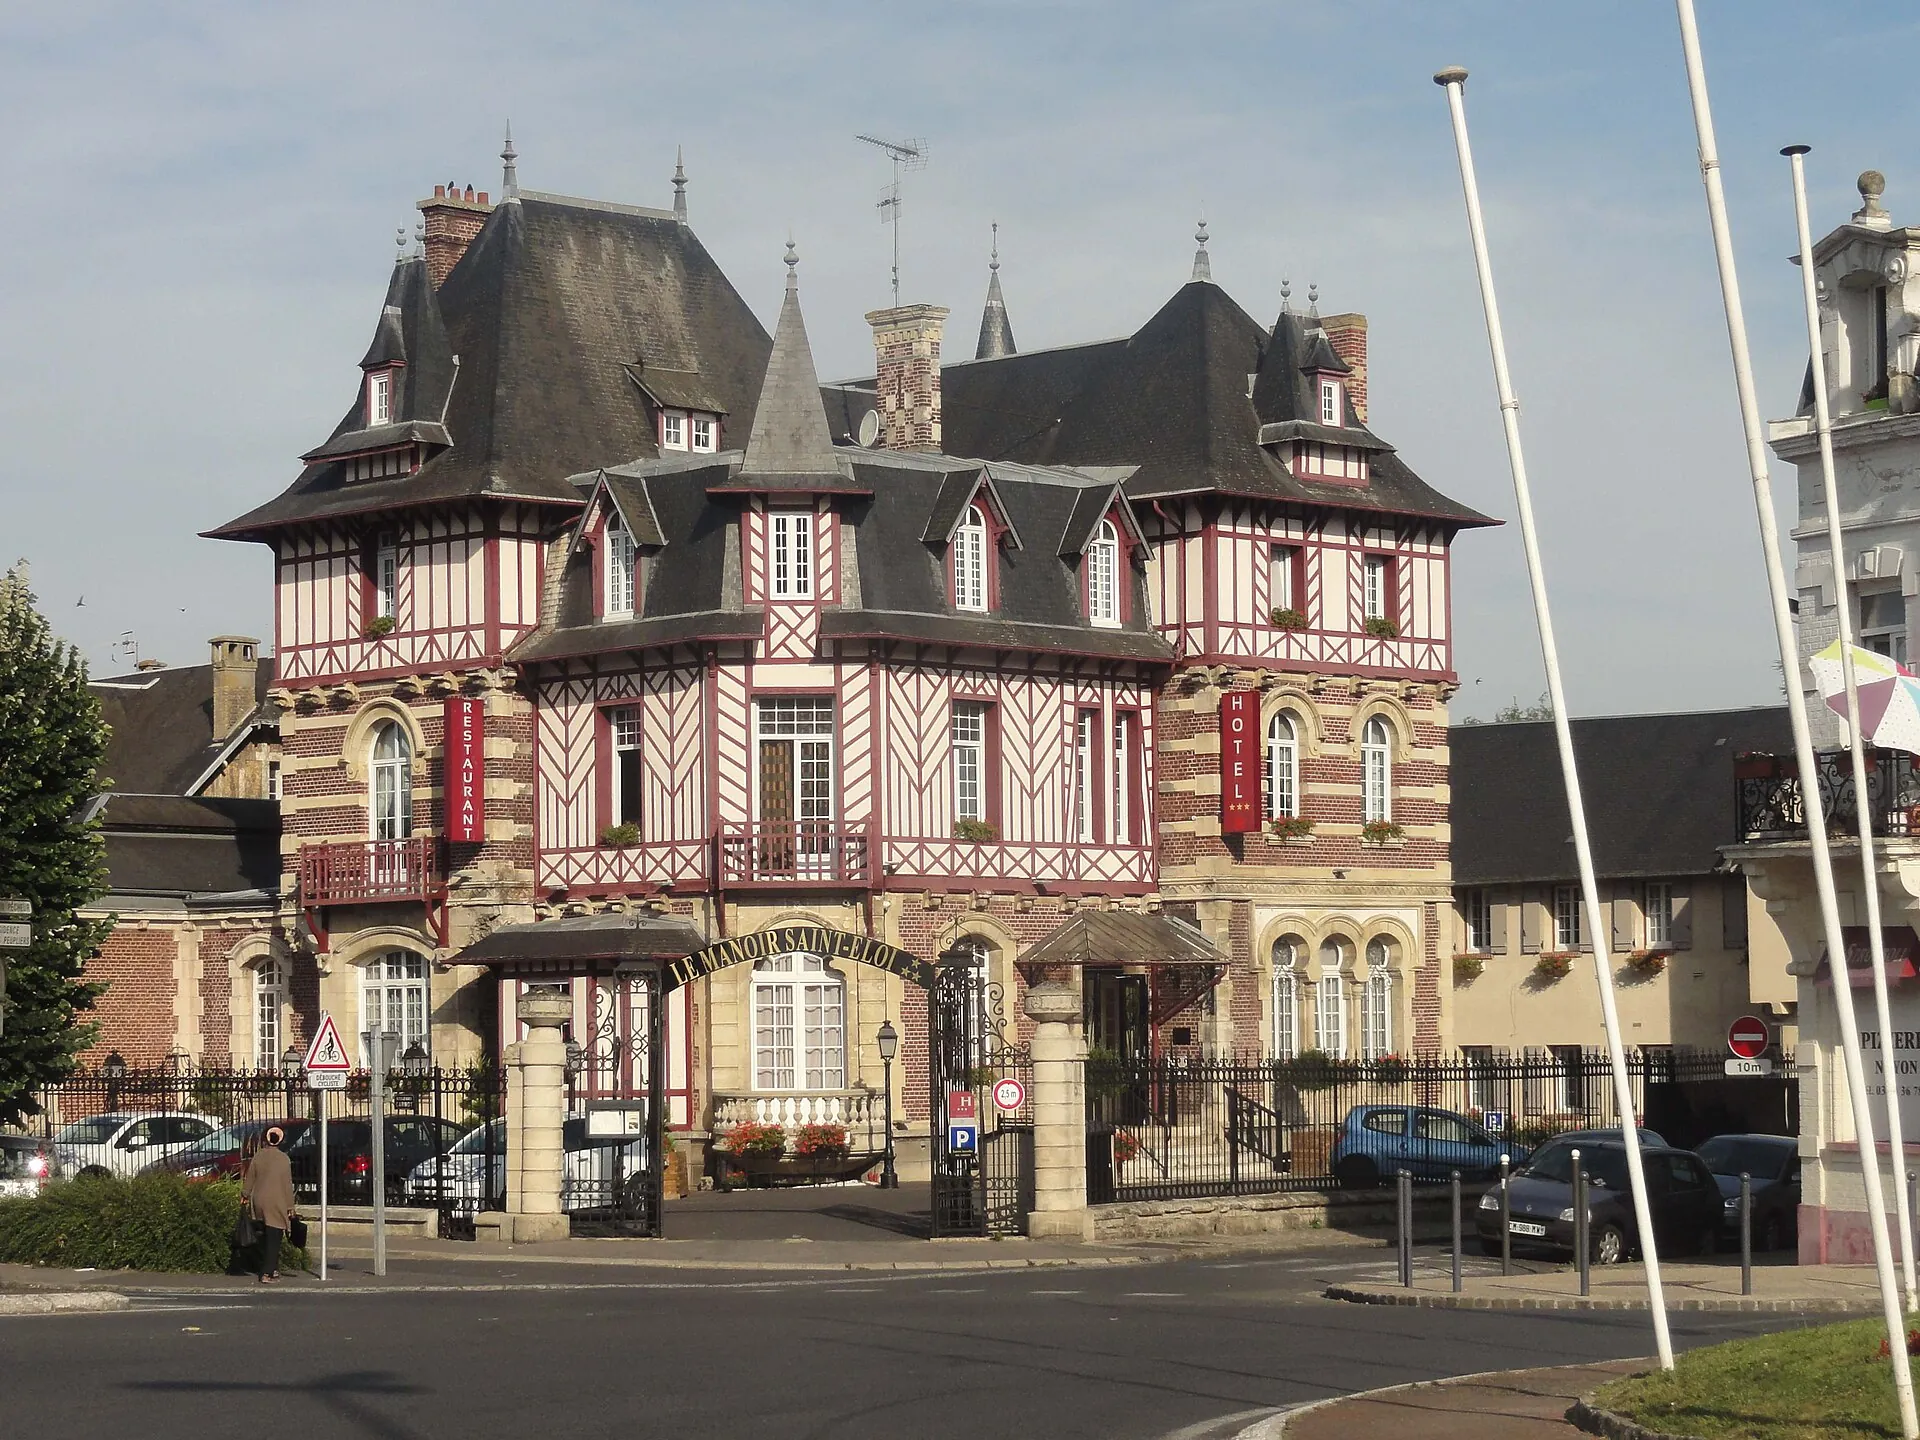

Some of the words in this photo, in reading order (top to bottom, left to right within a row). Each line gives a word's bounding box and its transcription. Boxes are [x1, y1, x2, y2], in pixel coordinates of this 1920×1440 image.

[1231, 695, 1244, 799] HOTEL
[462, 702, 474, 840] RESTAURANT
[669, 957, 700, 985] LE
[701, 930, 781, 971] MANOIR
[785, 928, 898, 970] SAINT-ELOI
[1875, 1060, 1918, 1074] NYON
[961, 1096, 972, 1107] H
[956, 1130, 970, 1148] P
